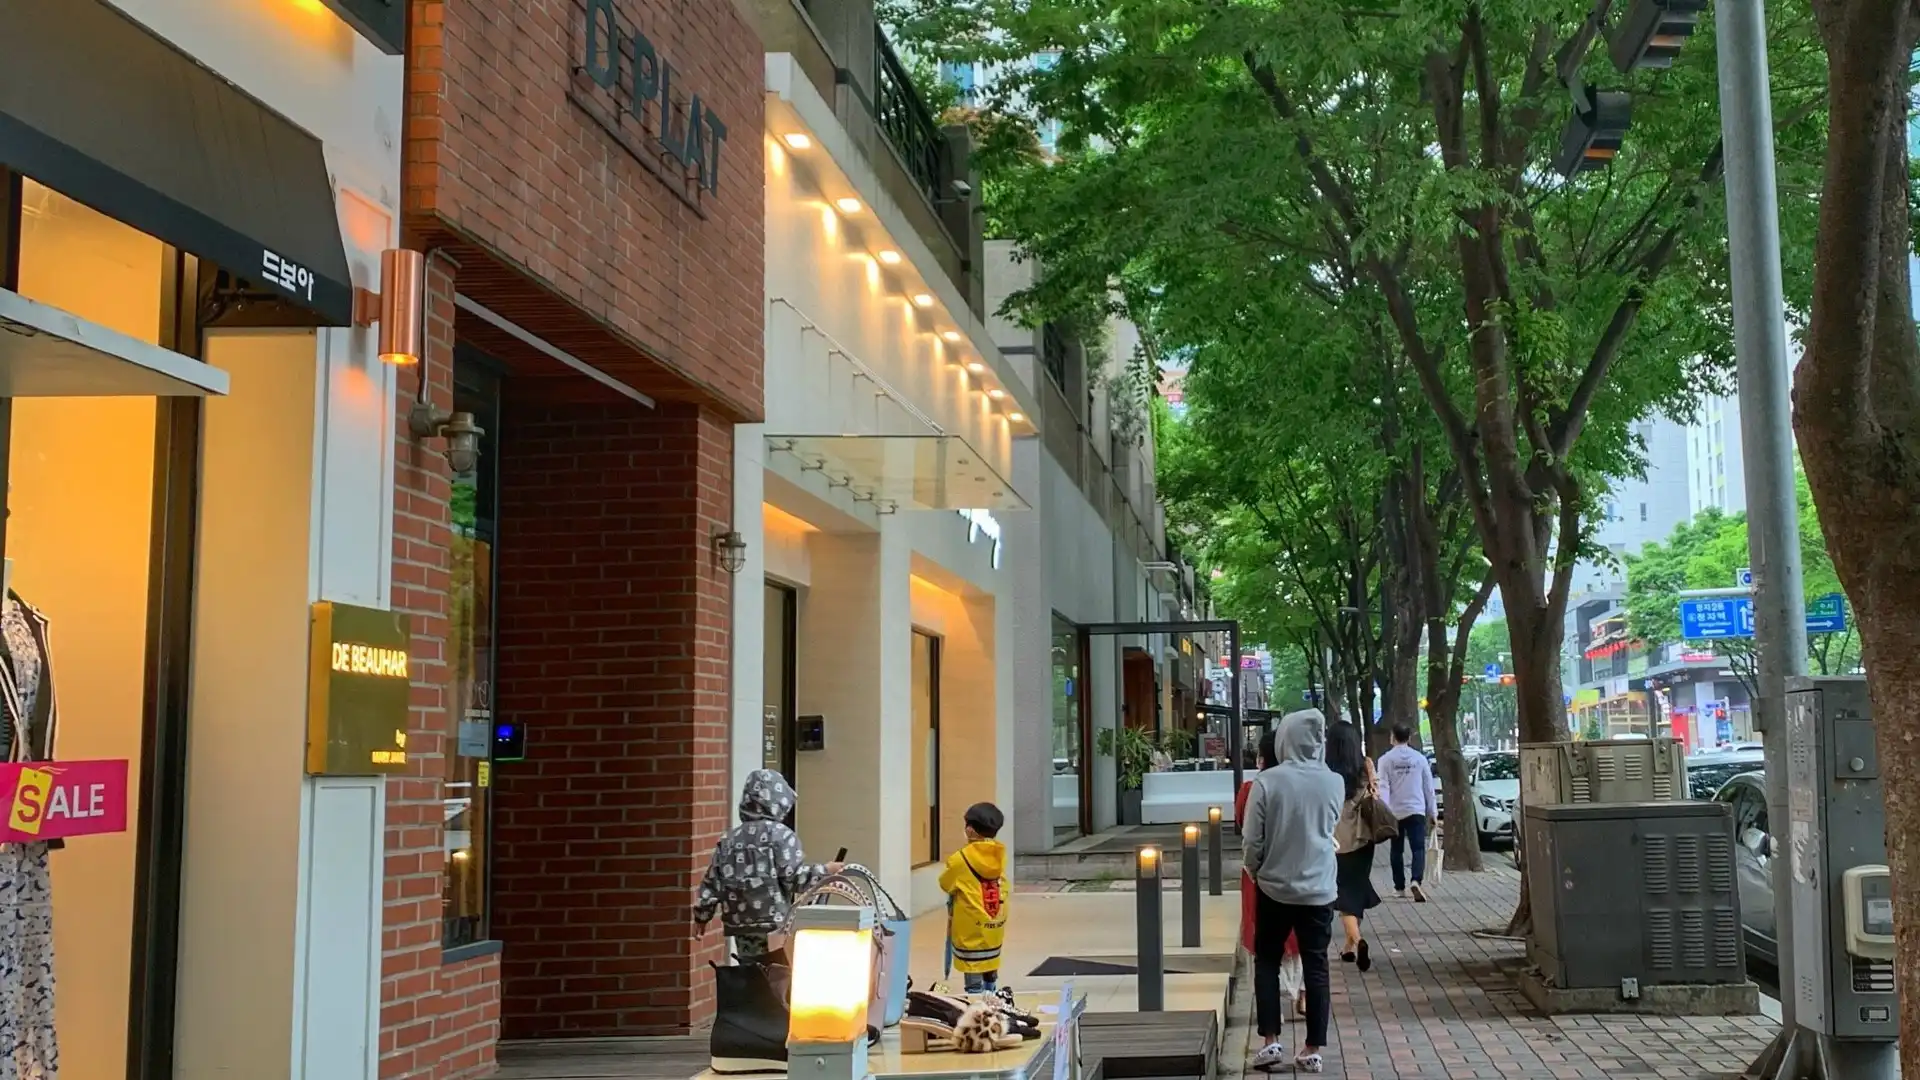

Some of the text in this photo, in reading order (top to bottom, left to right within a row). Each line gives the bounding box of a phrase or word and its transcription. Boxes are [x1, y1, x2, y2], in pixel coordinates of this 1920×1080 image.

[262, 249, 314, 301] 드보아
[332, 642, 408, 678] DE BEAUHAR
[17, 784, 105, 823] SALE
